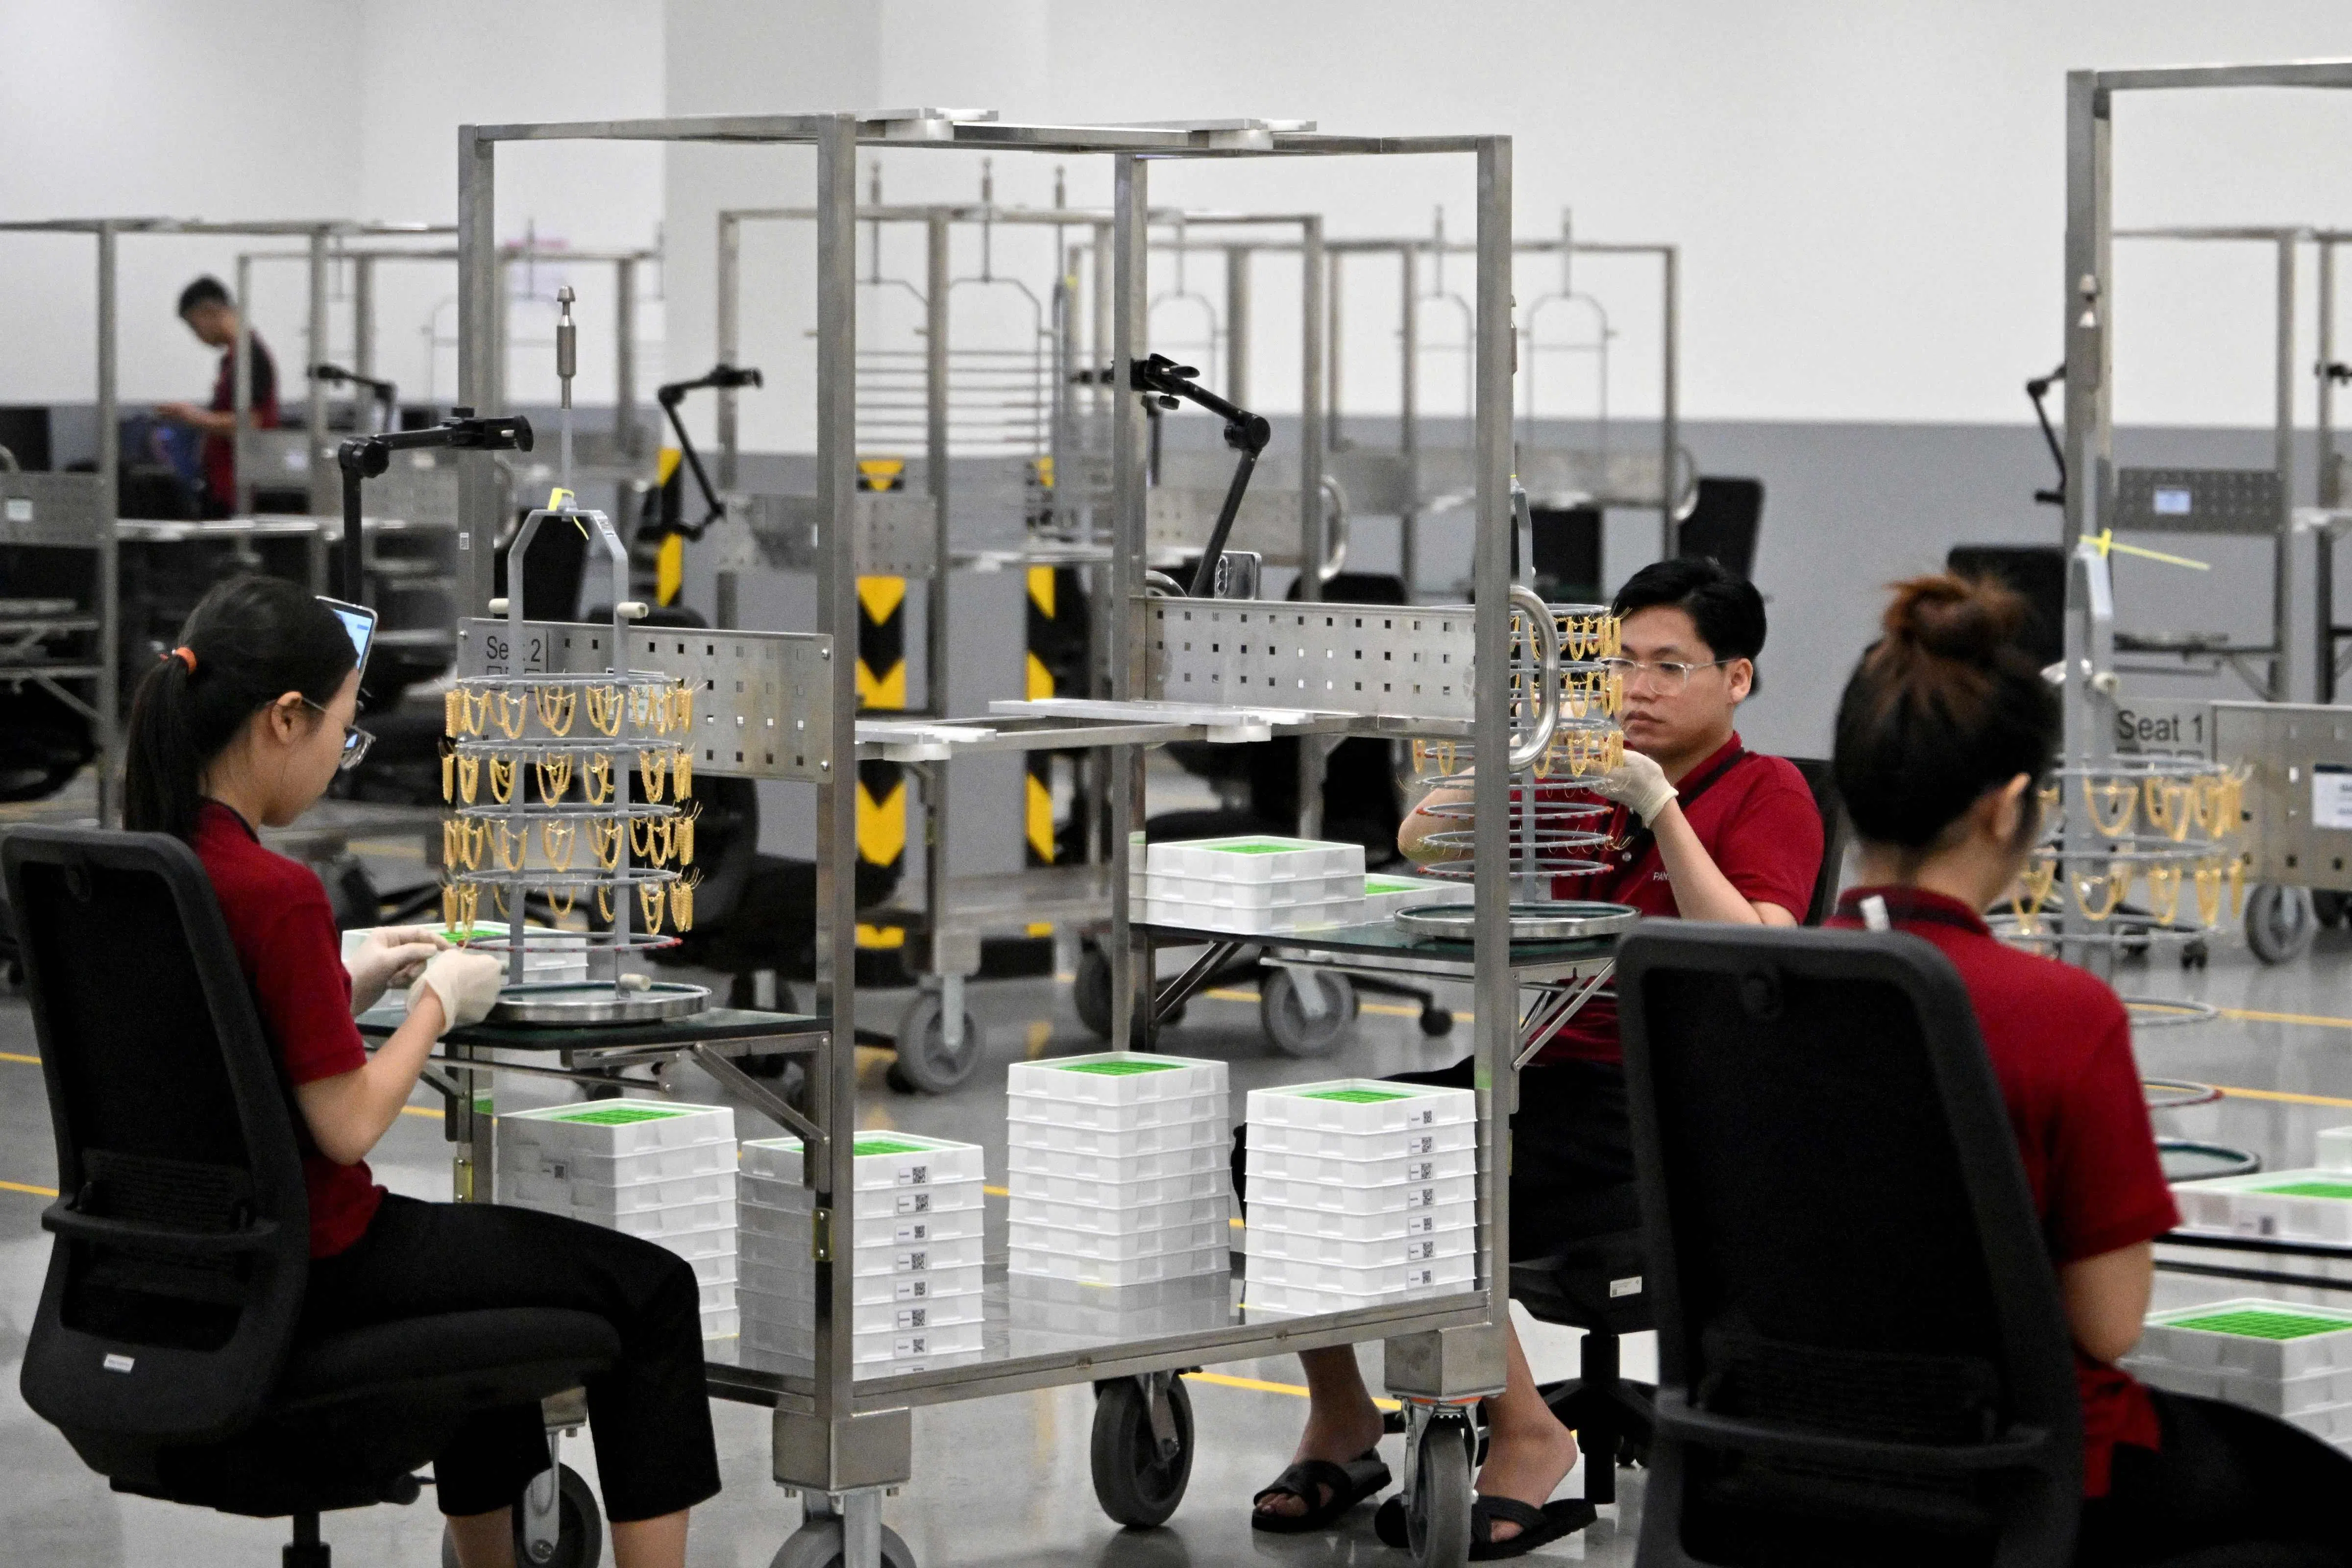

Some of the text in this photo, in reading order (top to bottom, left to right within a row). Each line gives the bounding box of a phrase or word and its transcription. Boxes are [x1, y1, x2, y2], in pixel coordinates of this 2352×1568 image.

[487, 636, 540, 662] Se 2
[2117, 709, 2203, 743] Seat 1
[1653, 872, 1669, 881] PAN
